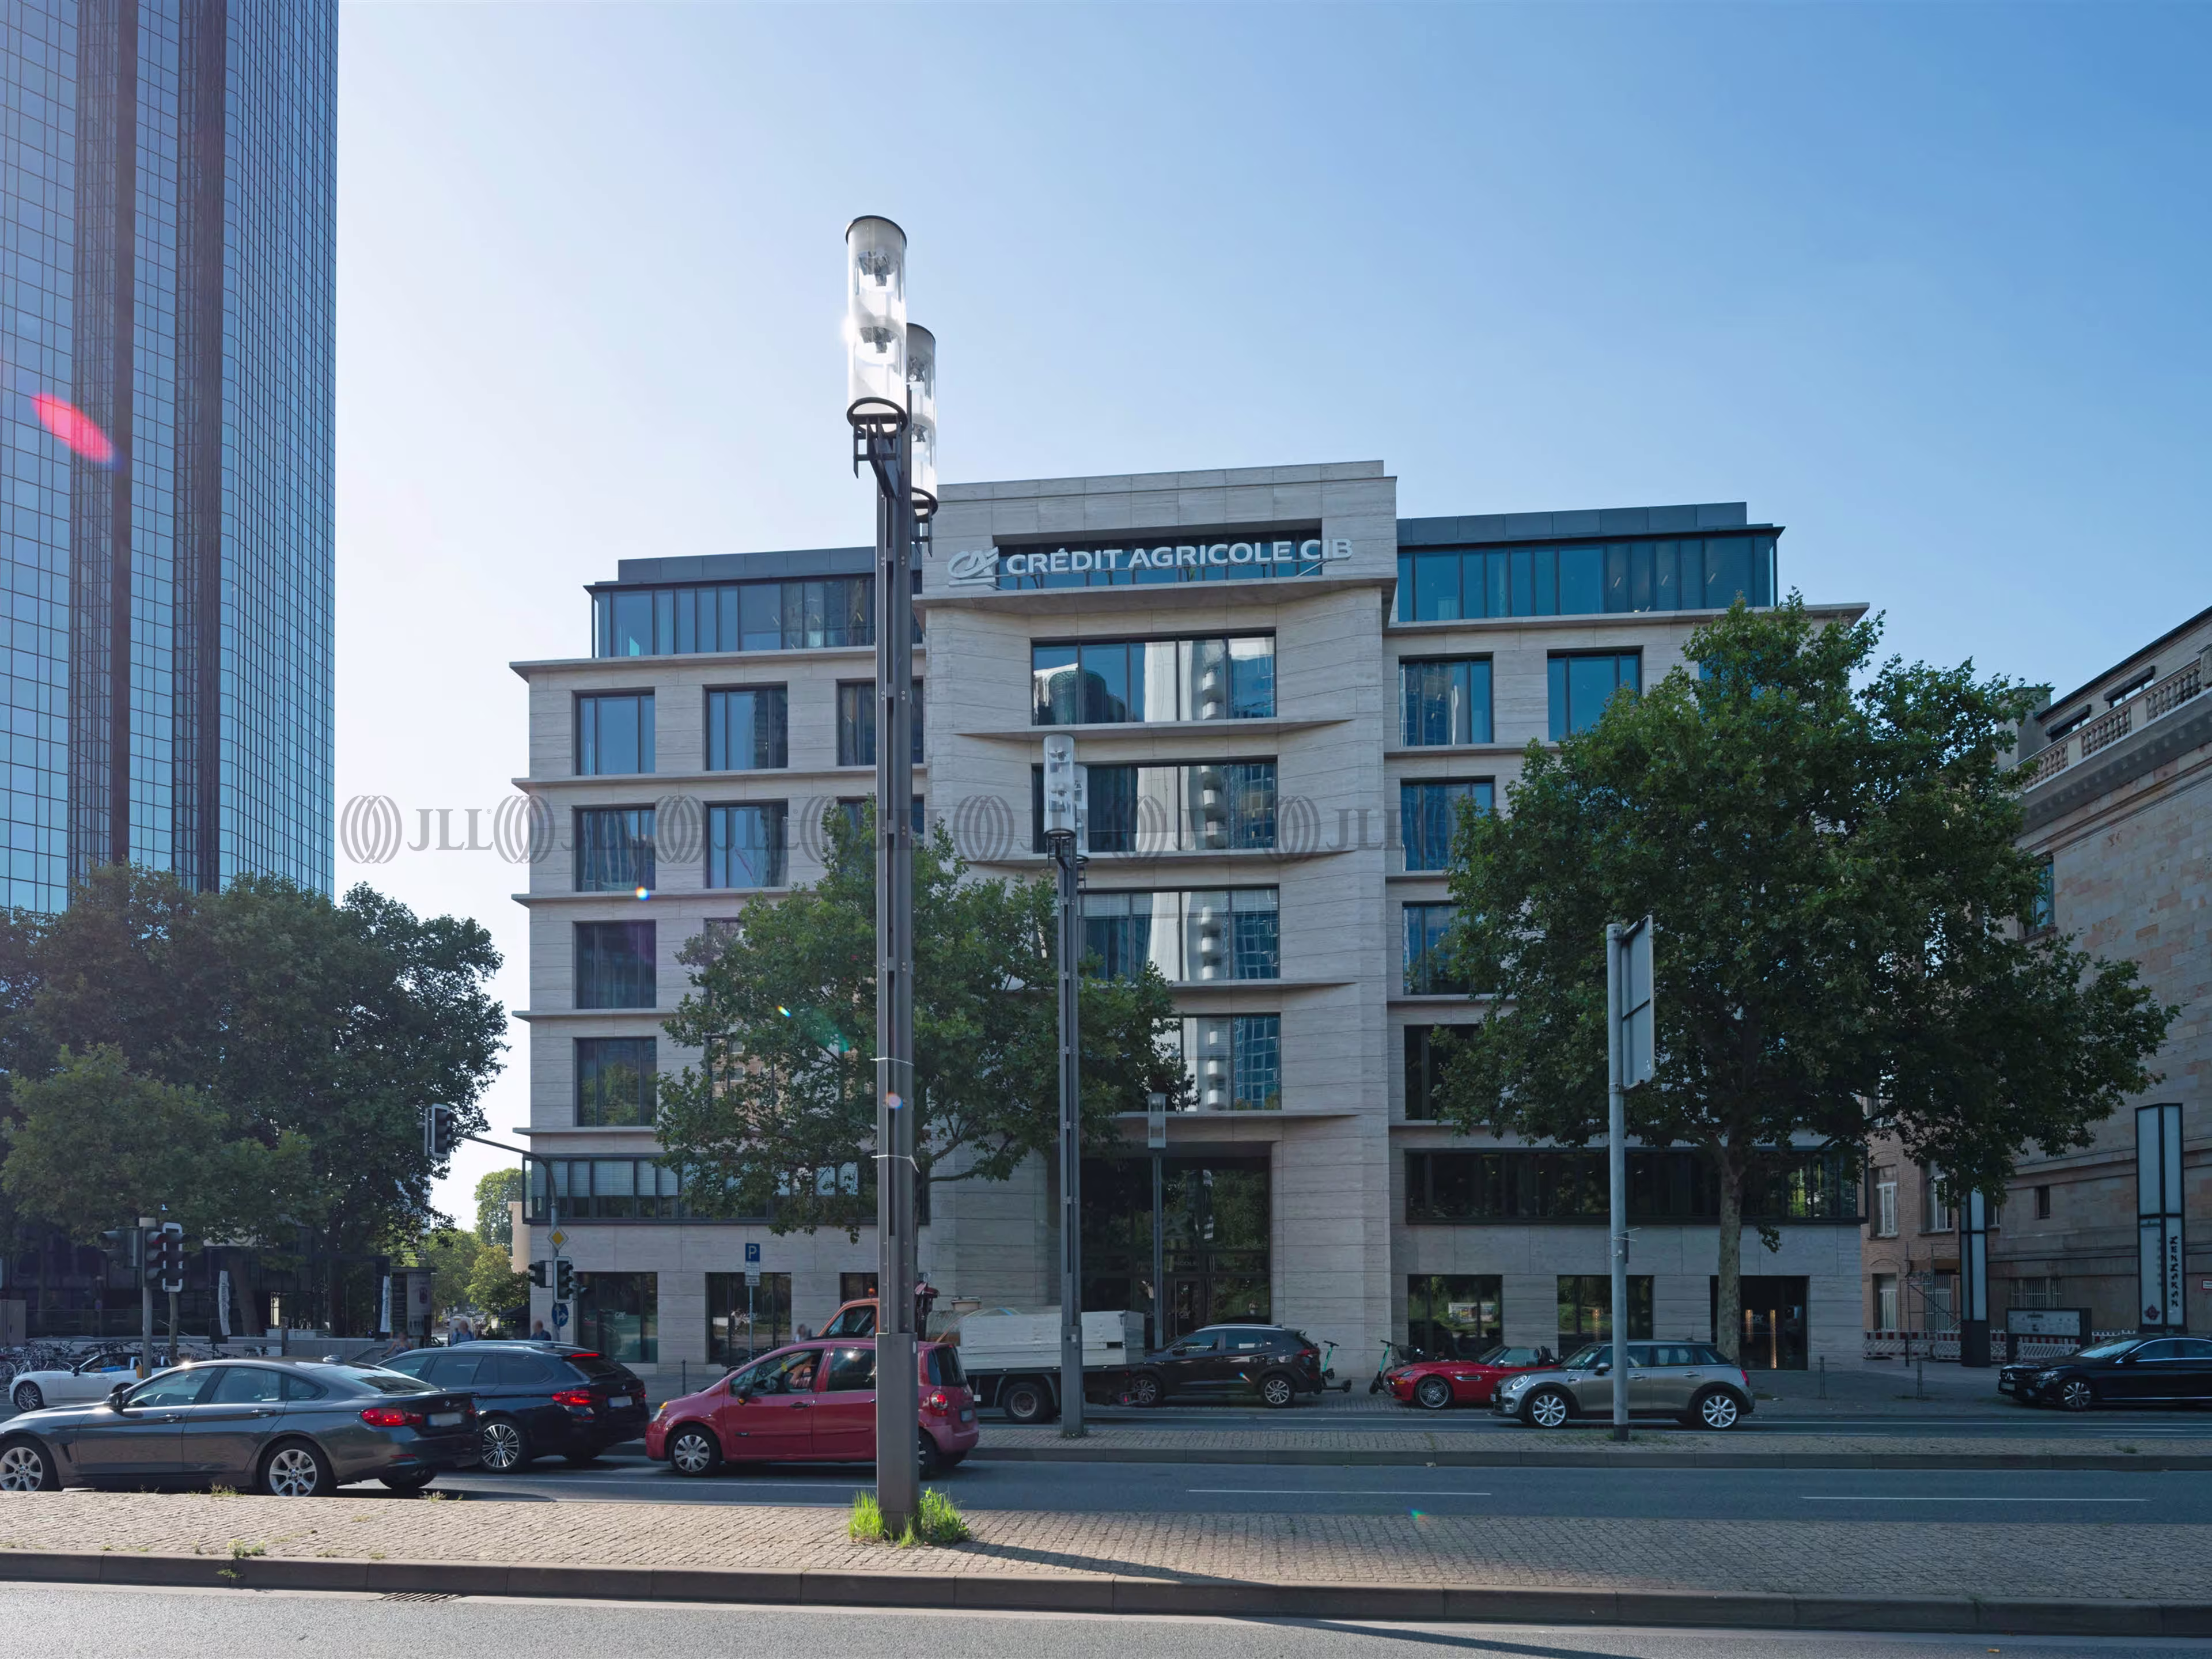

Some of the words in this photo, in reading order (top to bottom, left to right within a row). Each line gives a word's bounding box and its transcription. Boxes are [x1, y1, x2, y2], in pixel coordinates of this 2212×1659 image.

[1006, 548, 1123, 575] CRÉDIT
[1128, 541, 1292, 569] AGRICOLE
[1301, 539, 1353, 560] CIB
[748, 1245, 757, 1259] P
